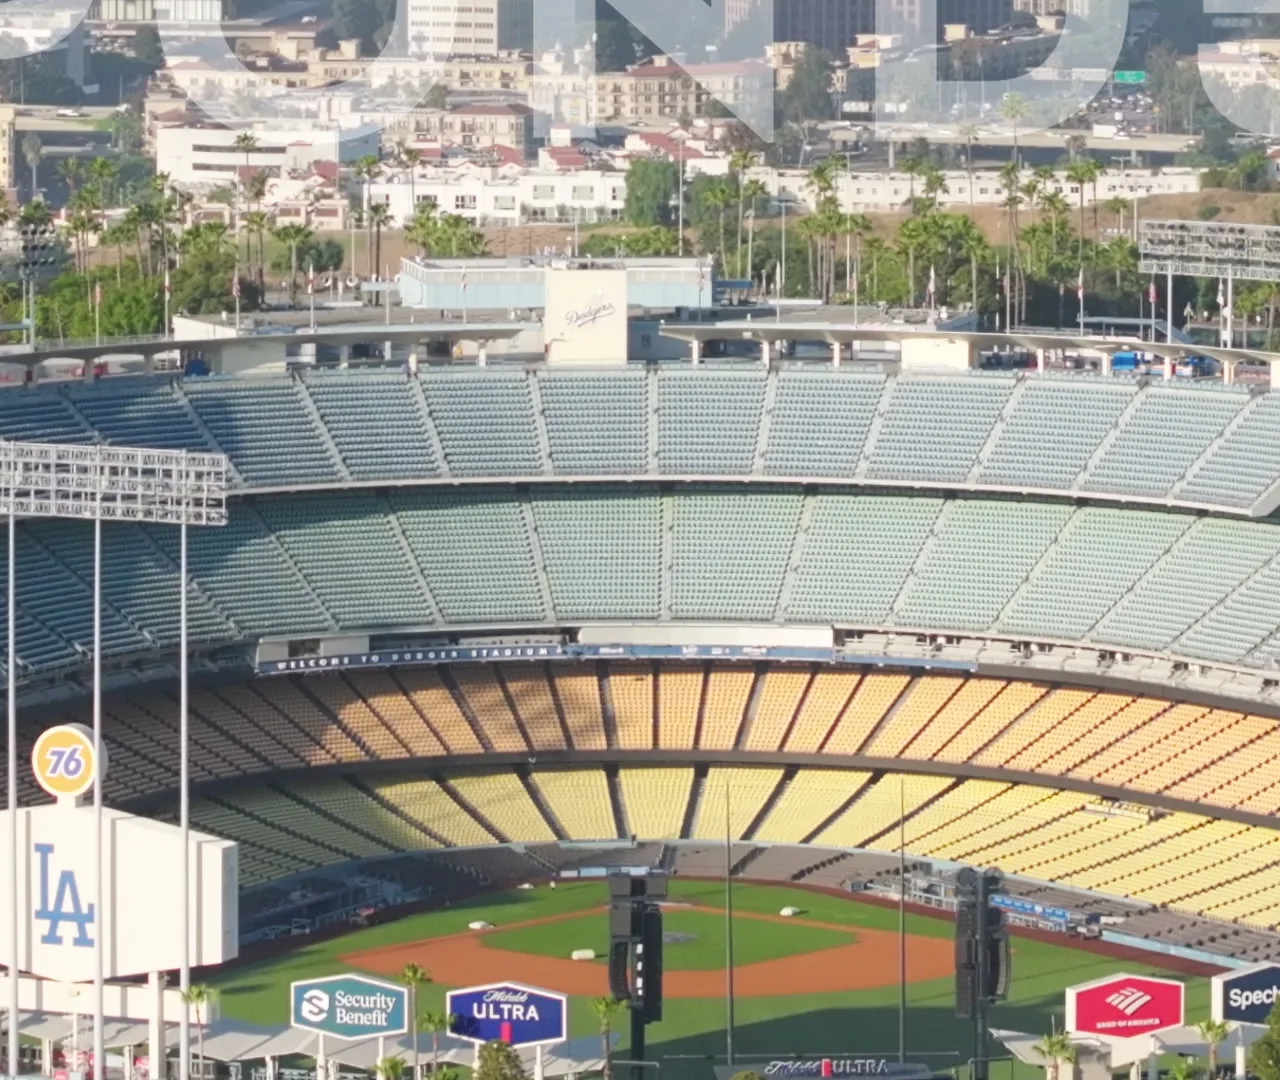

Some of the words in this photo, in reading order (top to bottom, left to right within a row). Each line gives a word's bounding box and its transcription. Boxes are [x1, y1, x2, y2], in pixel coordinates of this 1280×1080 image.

[565, 302, 616, 327] Dodgers
[277, 656, 350, 671] WELCOME
[361, 654, 380, 664] TO
[391, 650, 459, 662] DODGER
[472, 648, 548, 658] STADIUM
[47, 746, 83, 778] 76
[33, 842, 96, 948] LA
[335, 991, 396, 1013] Security
[473, 1002, 540, 1021] ULTRA
[336, 1007, 388, 1027] Benefit
[833, 1058, 889, 1074] ULTRA
